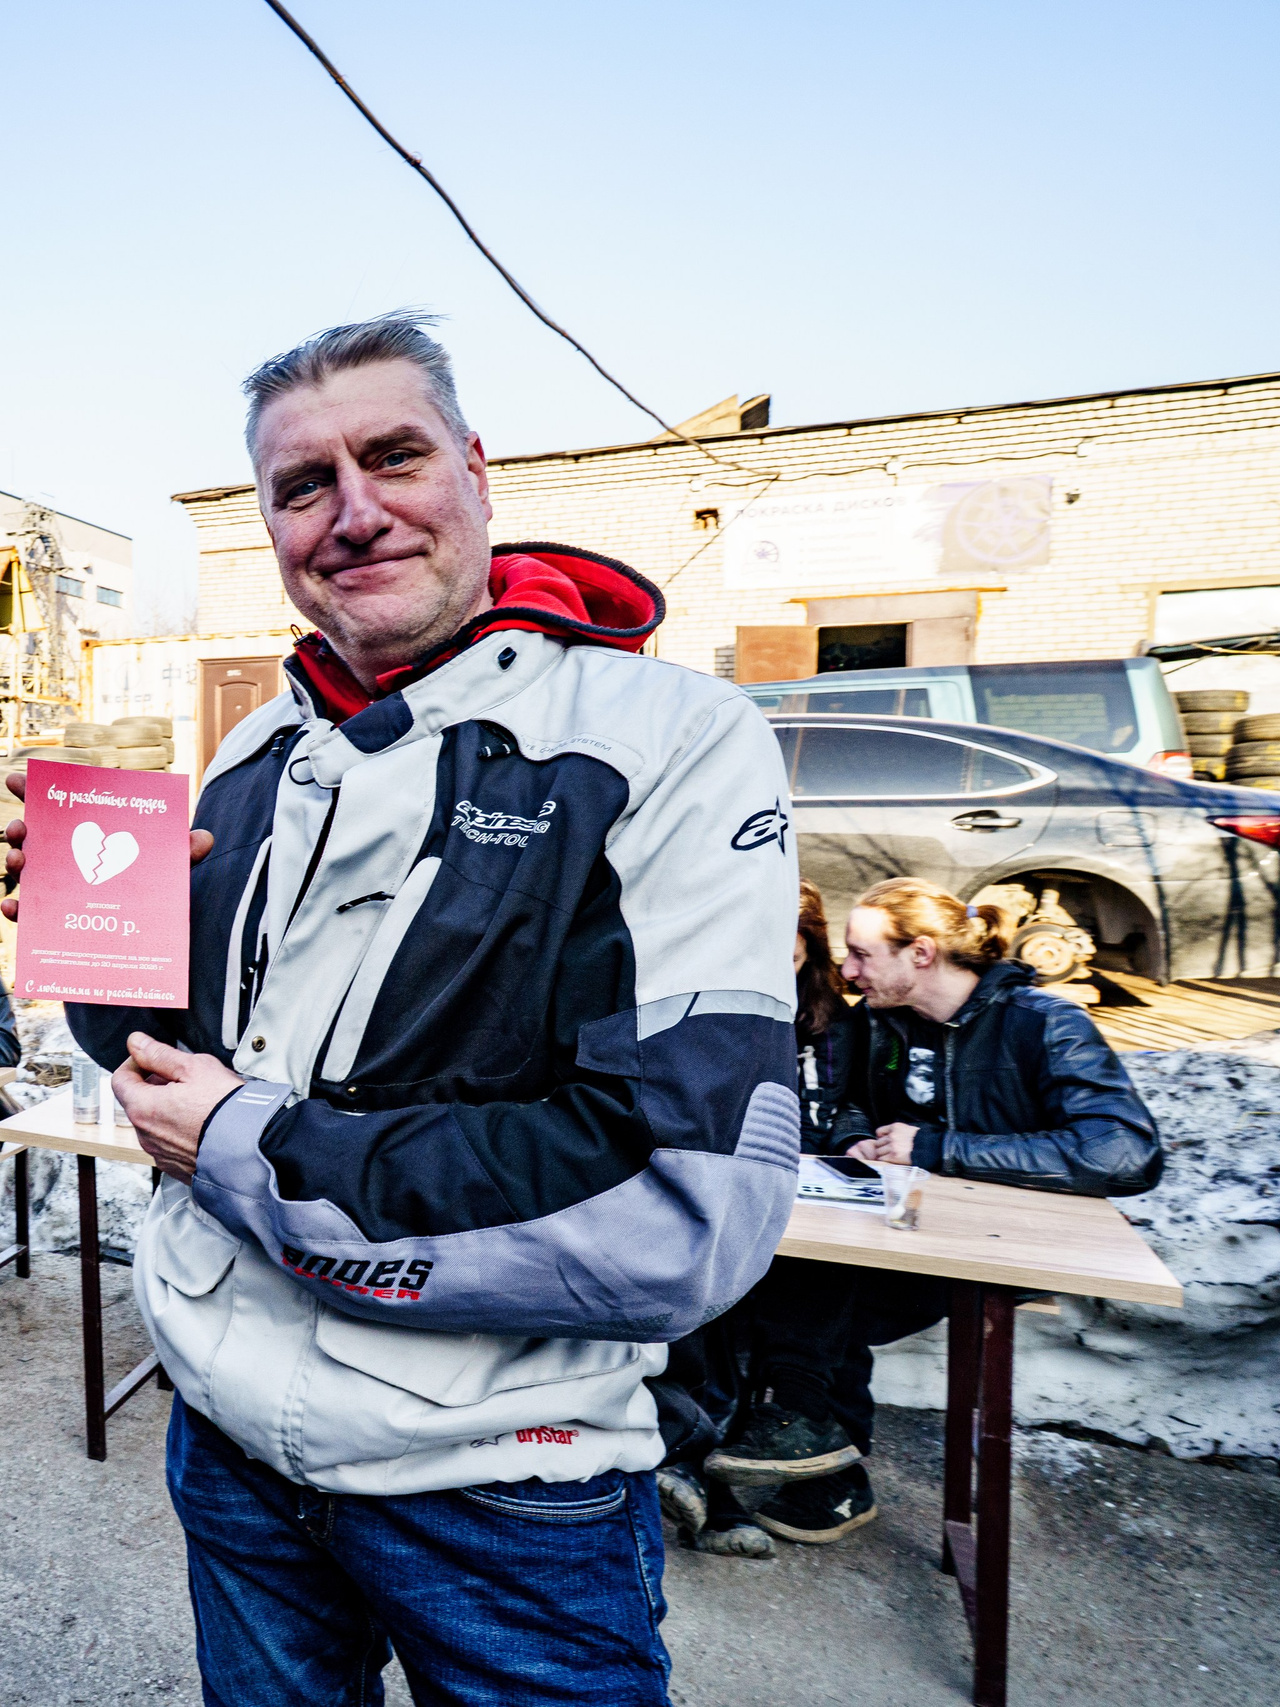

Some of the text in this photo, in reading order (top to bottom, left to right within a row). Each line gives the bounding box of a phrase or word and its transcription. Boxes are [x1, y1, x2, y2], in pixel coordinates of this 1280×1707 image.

[570, 738, 612, 751] SYSTEM
[47, 784, 167, 814] бар разбитых сердец
[64, 913, 141, 936] 2000 р.
[24, 979, 35, 993] С
[93, 987, 104, 997] не
[106, 986, 176, 1001] расставайтесь
